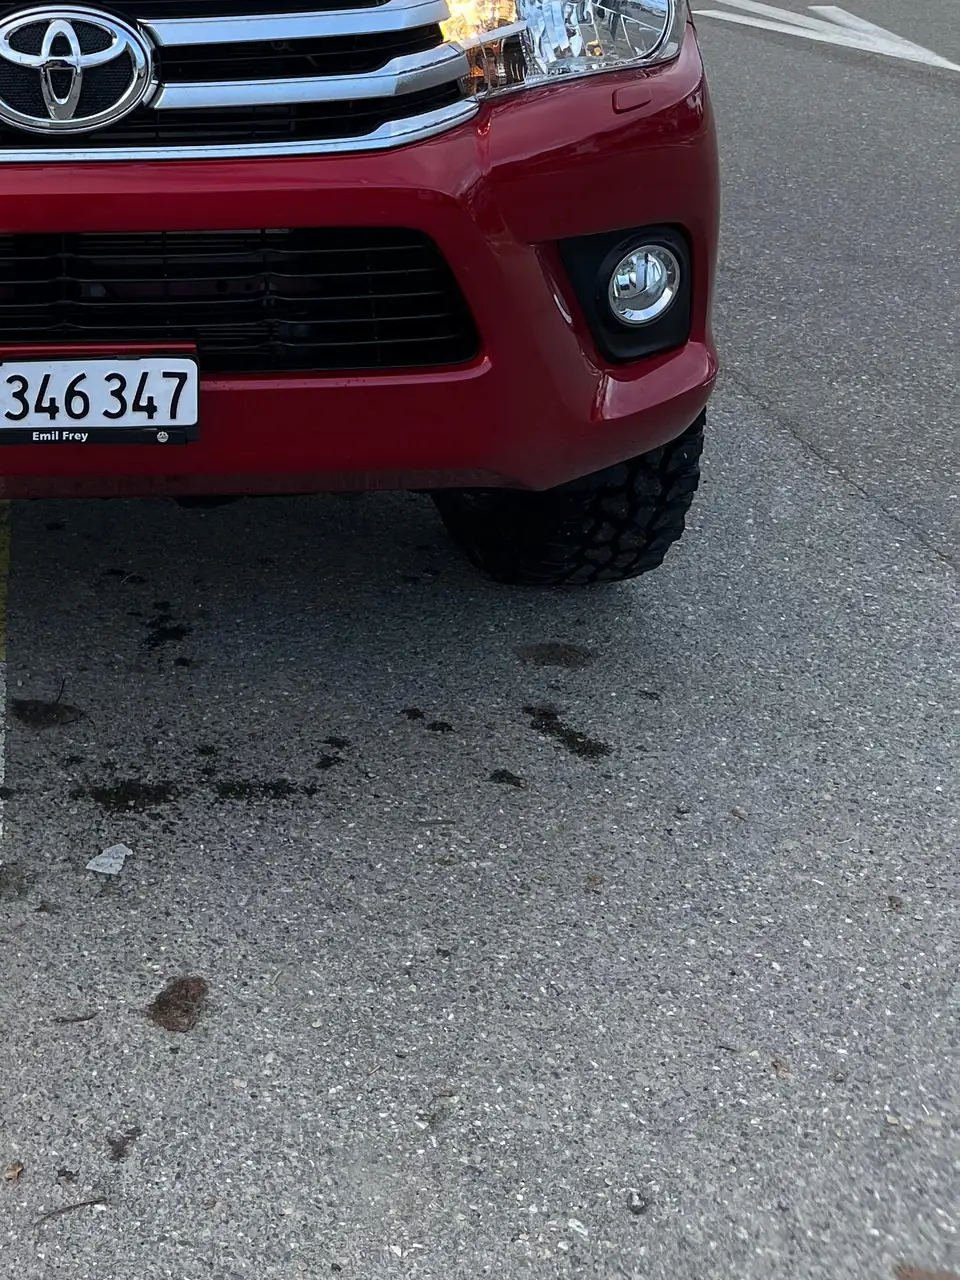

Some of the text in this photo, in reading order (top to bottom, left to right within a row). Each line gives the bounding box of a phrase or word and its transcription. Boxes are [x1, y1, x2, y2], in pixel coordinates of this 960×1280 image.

[102, 371, 188, 420] 347
[32, 431, 89, 443] Emil Frey
